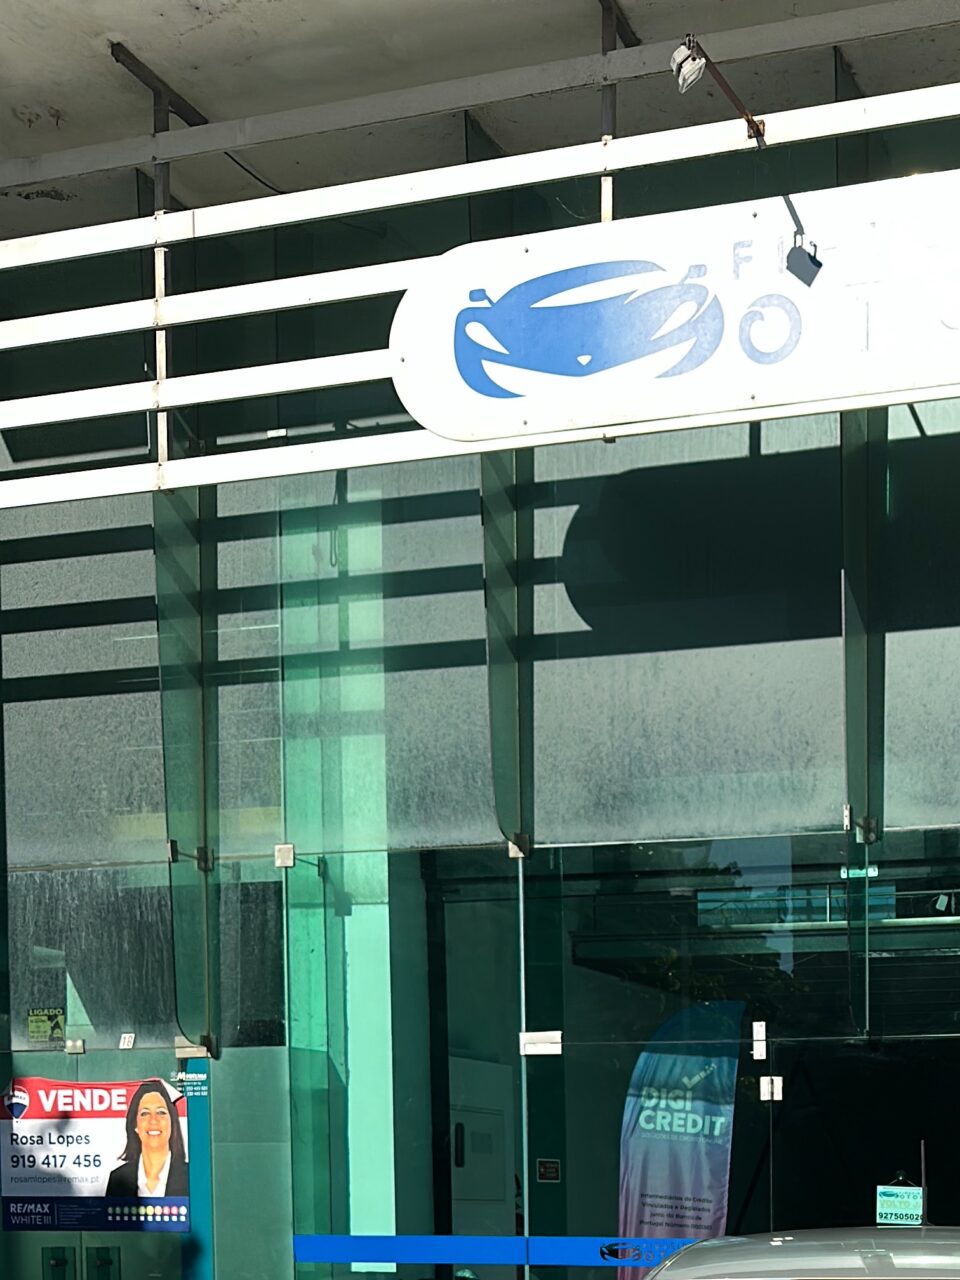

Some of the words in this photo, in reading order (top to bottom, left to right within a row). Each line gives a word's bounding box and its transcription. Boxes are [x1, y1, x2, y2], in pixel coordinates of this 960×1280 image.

[37, 1088, 128, 1112] VENDE
[640, 1087, 693, 1111] DIGI
[639, 1109, 726, 1137] CREDIT
[10, 1133, 44, 1145] Rosa
[48, 1132, 91, 1147] Lopes
[10, 1154, 37, 1168] 919
[41, 1154, 67, 1168] 417
[73, 1154, 102, 1168] 456
[10, 1203, 50, 1214] RE/MAX
[10, 1215, 42, 1225] WHITE
